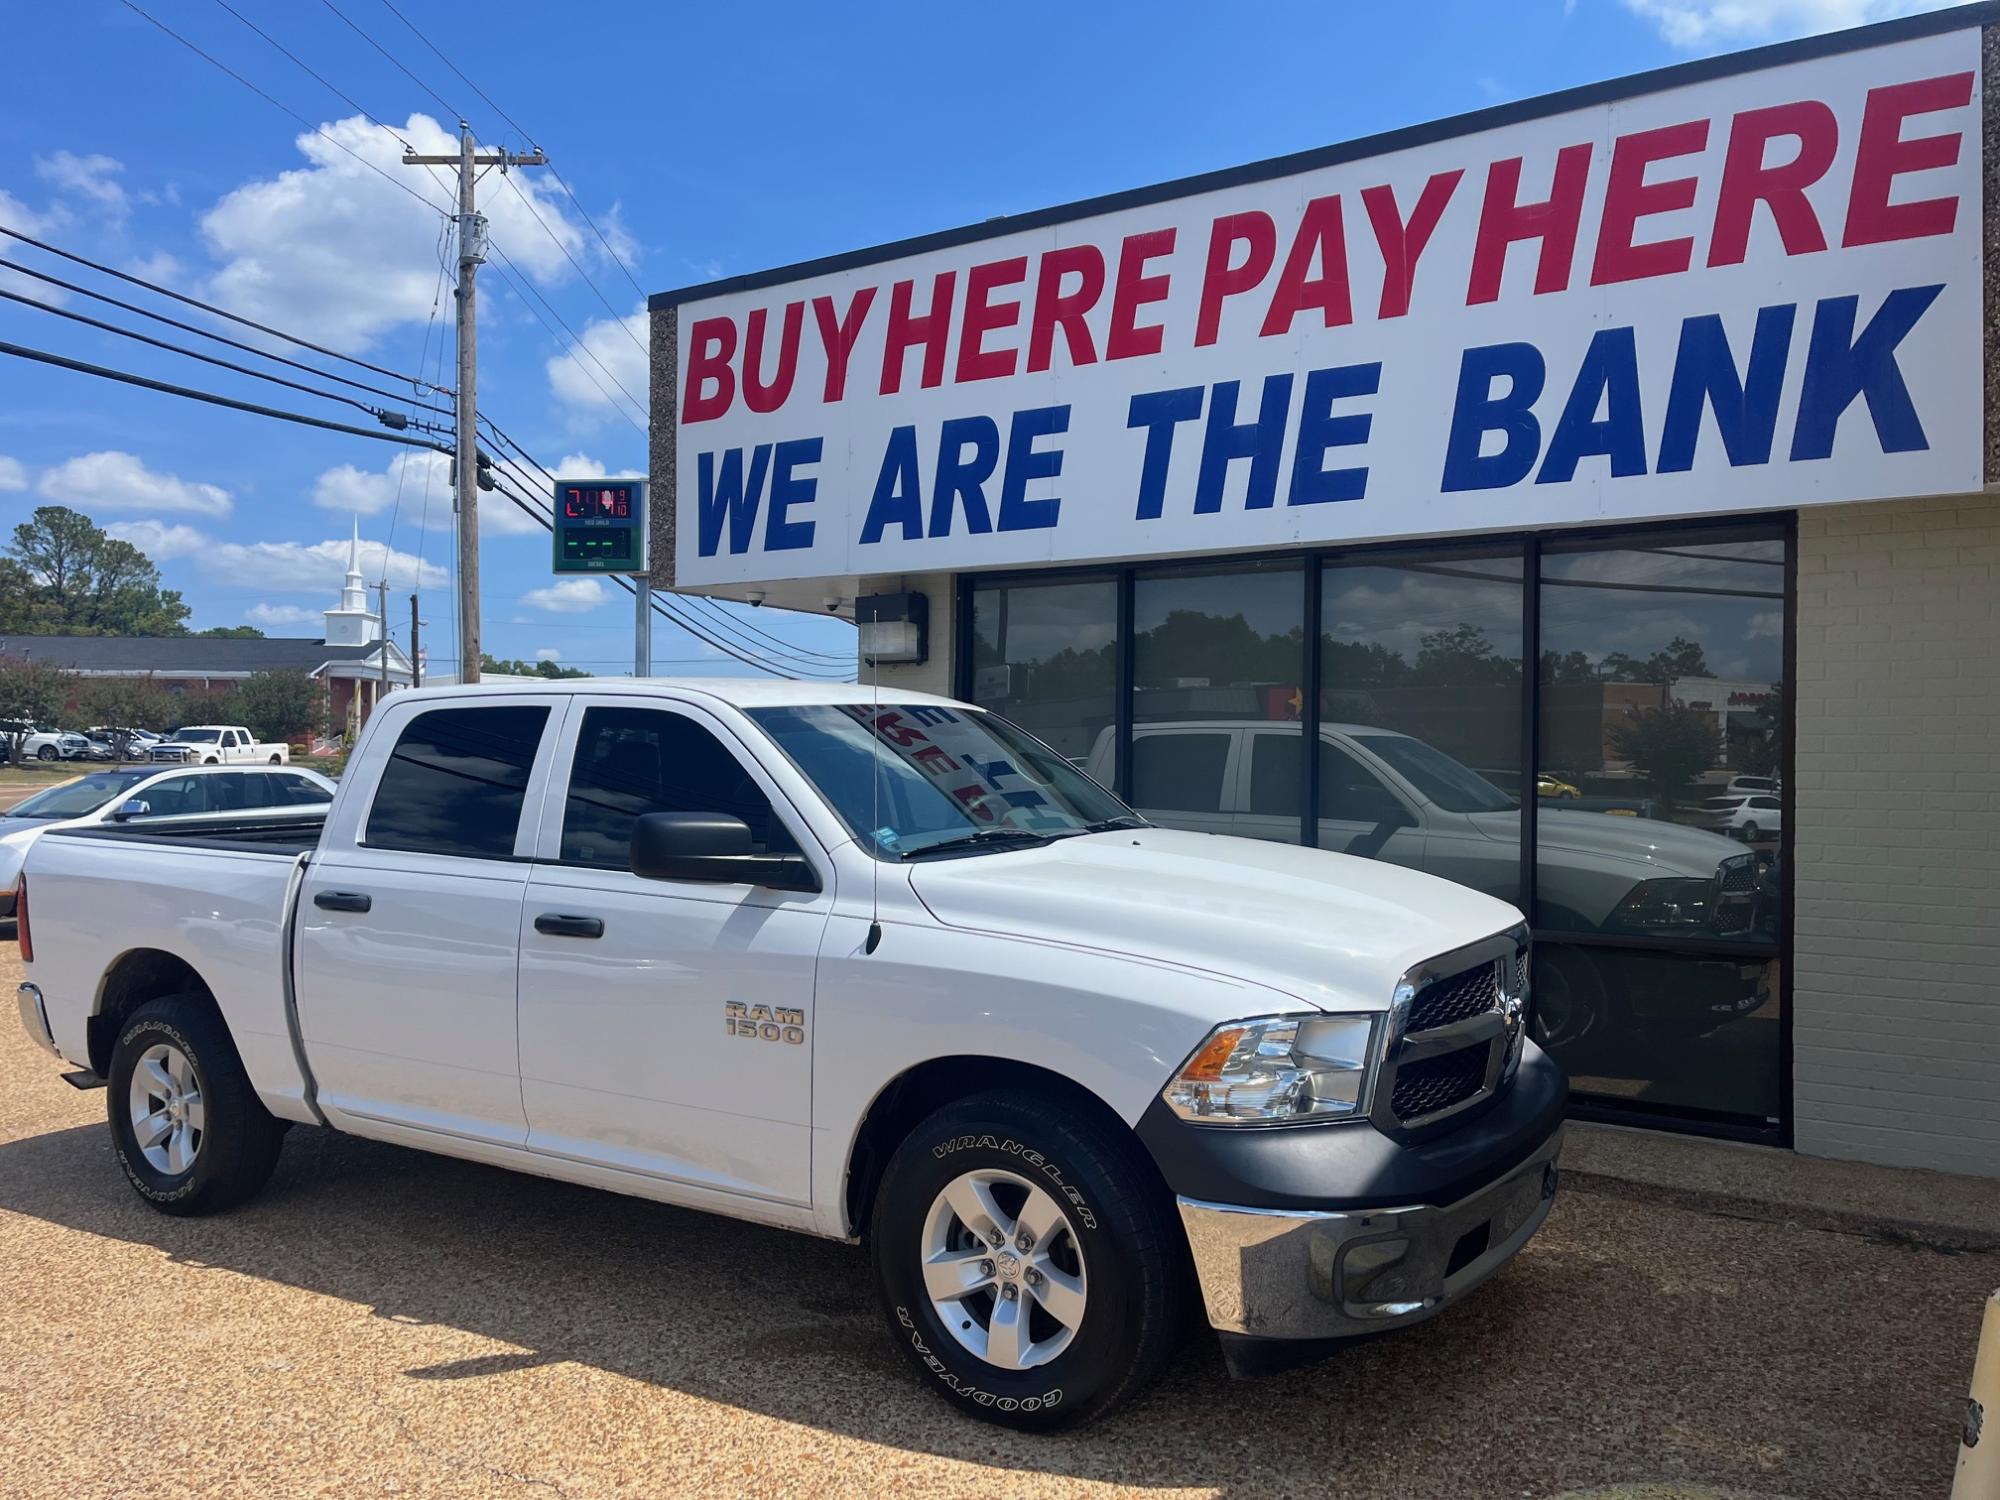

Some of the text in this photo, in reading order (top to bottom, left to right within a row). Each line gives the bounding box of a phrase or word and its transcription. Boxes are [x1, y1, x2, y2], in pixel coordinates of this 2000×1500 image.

[682, 70, 1975, 425] BUY HERE PAY HERE
[698, 283, 1947, 558] WE ARE THE BANK
[725, 1000, 805, 1027] RAM
[725, 1018, 805, 1046] 1500
[931, 1134, 1098, 1230] WRANGLER
[895, 1305, 1064, 1412] GOODYEAR
